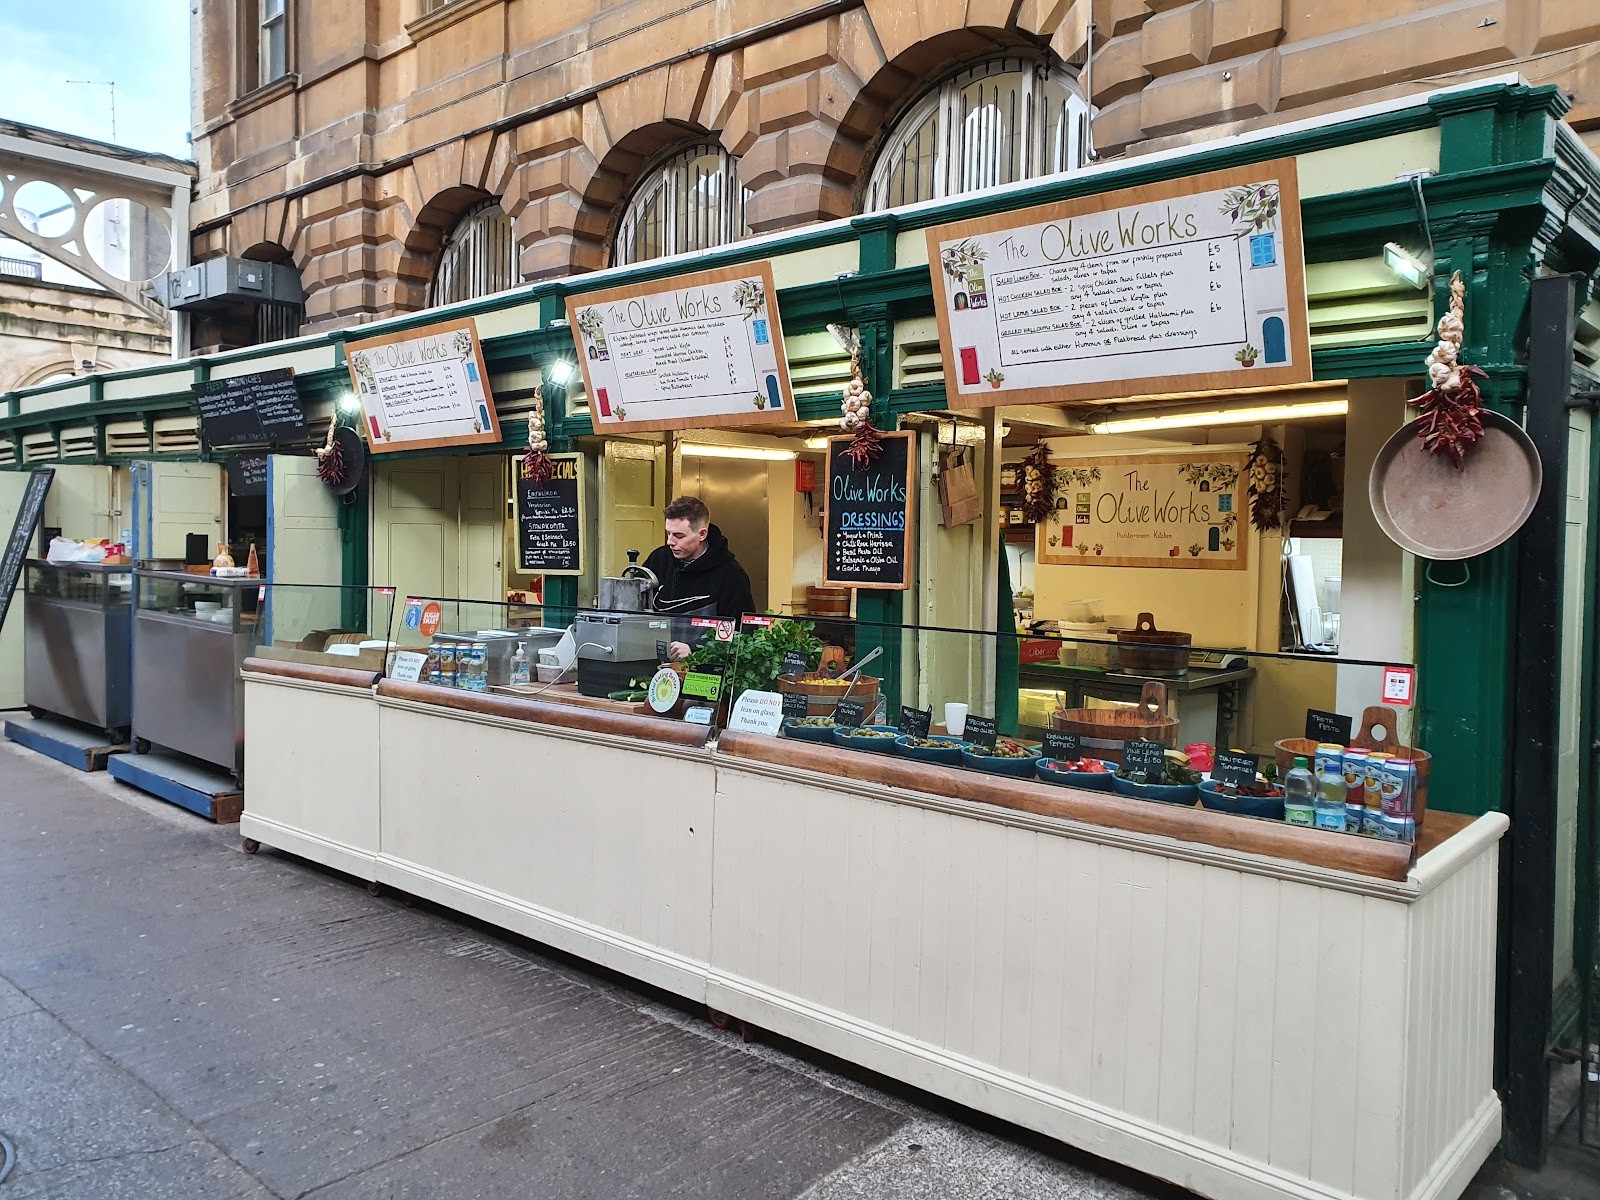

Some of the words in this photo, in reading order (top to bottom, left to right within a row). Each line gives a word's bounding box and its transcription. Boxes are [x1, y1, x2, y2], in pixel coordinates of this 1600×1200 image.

[999, 236, 1029, 261] The
[1040, 219, 1114, 262] Olive
[1117, 205, 1197, 249] Works
[1132, 256, 1154, 267] freshly
[1156, 249, 1183, 263] prepared
[1208, 243, 1221, 257] £5
[1069, 284, 1074, 292] 2
[1094, 278, 1118, 288] Chicken
[1135, 272, 1158, 281] Fillets
[1159, 269, 1174, 280] plus
[1209, 261, 1222, 273] £6
[1070, 294, 1082, 302] any
[1083, 290, 1090, 298] 4
[1071, 303, 1076, 311] 2
[1079, 302, 1098, 312] pieces
[1101, 300, 1108, 308] of
[1108, 296, 1127, 305] Lamb
[1153, 290, 1168, 300] plus
[1209, 281, 1222, 294] £6
[607, 305, 626, 325] The
[627, 298, 671, 329] Olive
[675, 289, 723, 320] Works
[1091, 319, 1097, 327] 2
[1124, 314, 1146, 324] grilled
[1180, 308, 1195, 318] plus
[1209, 302, 1222, 313] £6
[1072, 312, 1084, 322] any
[1075, 330, 1087, 338] any
[1150, 319, 1170, 328] tapas
[1020, 346, 1039, 354] served
[1053, 343, 1072, 351] either
[1113, 334, 1147, 344] Flatbread
[1149, 333, 1163, 342] plus
[1164, 328, 1198, 340] dressings
[386, 345, 416, 368] Olive
[416, 337, 448, 361] Works
[1124, 470, 1150, 492] The
[833, 474, 865, 501] Olive
[866, 473, 907, 503] Works
[1096, 491, 1150, 524] Olive
[1153, 490, 1210, 524] Works
[841, 510, 905, 528] DRESSINGS
[867, 530, 884, 539] Mint
[872, 547, 883, 555] Oil
[885, 555, 898, 564] Oil
[841, 564, 860, 572] Garlic
[424, 611, 440, 620] SUGAR
[741, 696, 759, 704] Please
[768, 699, 781, 707] NOT
[740, 705, 753, 714] lean
[760, 708, 775, 718] glass,
[740, 716, 757, 725] Thank
[757, 720, 769, 728] you.
[1318, 722, 1341, 733] PESTO
[1130, 741, 1159, 750] STUFFED
[1126, 755, 1132, 763] 4
[1218, 755, 1232, 764] SUN
[1220, 762, 1254, 774] TOMATOES
